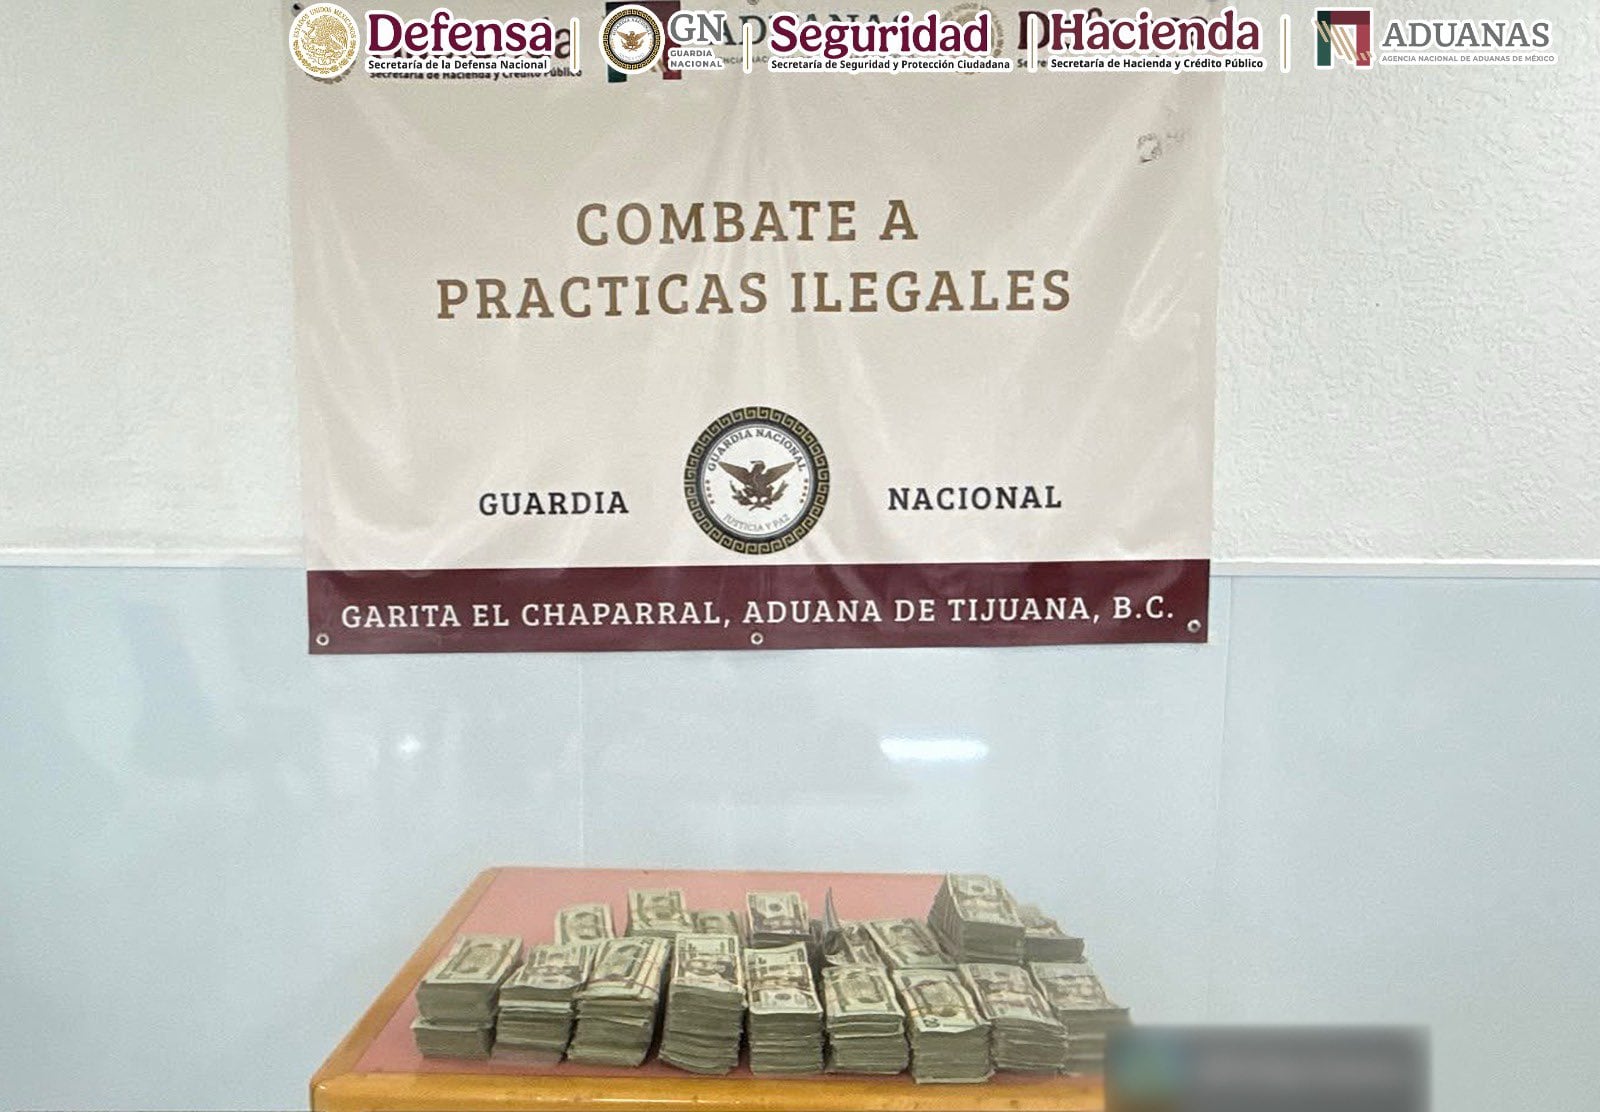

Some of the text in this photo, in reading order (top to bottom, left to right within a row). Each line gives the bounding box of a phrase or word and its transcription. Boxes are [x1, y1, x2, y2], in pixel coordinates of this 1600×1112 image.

[576, 199, 919, 246] COMBATE A
[437, 269, 1072, 320] PRACTICAS ILEGALES
[707, 428, 807, 473] GUARDIA NACIONAL
[478, 485, 1063, 517] GUARDIA NACIONAL
[341, 595, 1176, 629] GARITA EL CHAPARRAL, ADUANA DE TIJUANA, B.C.
